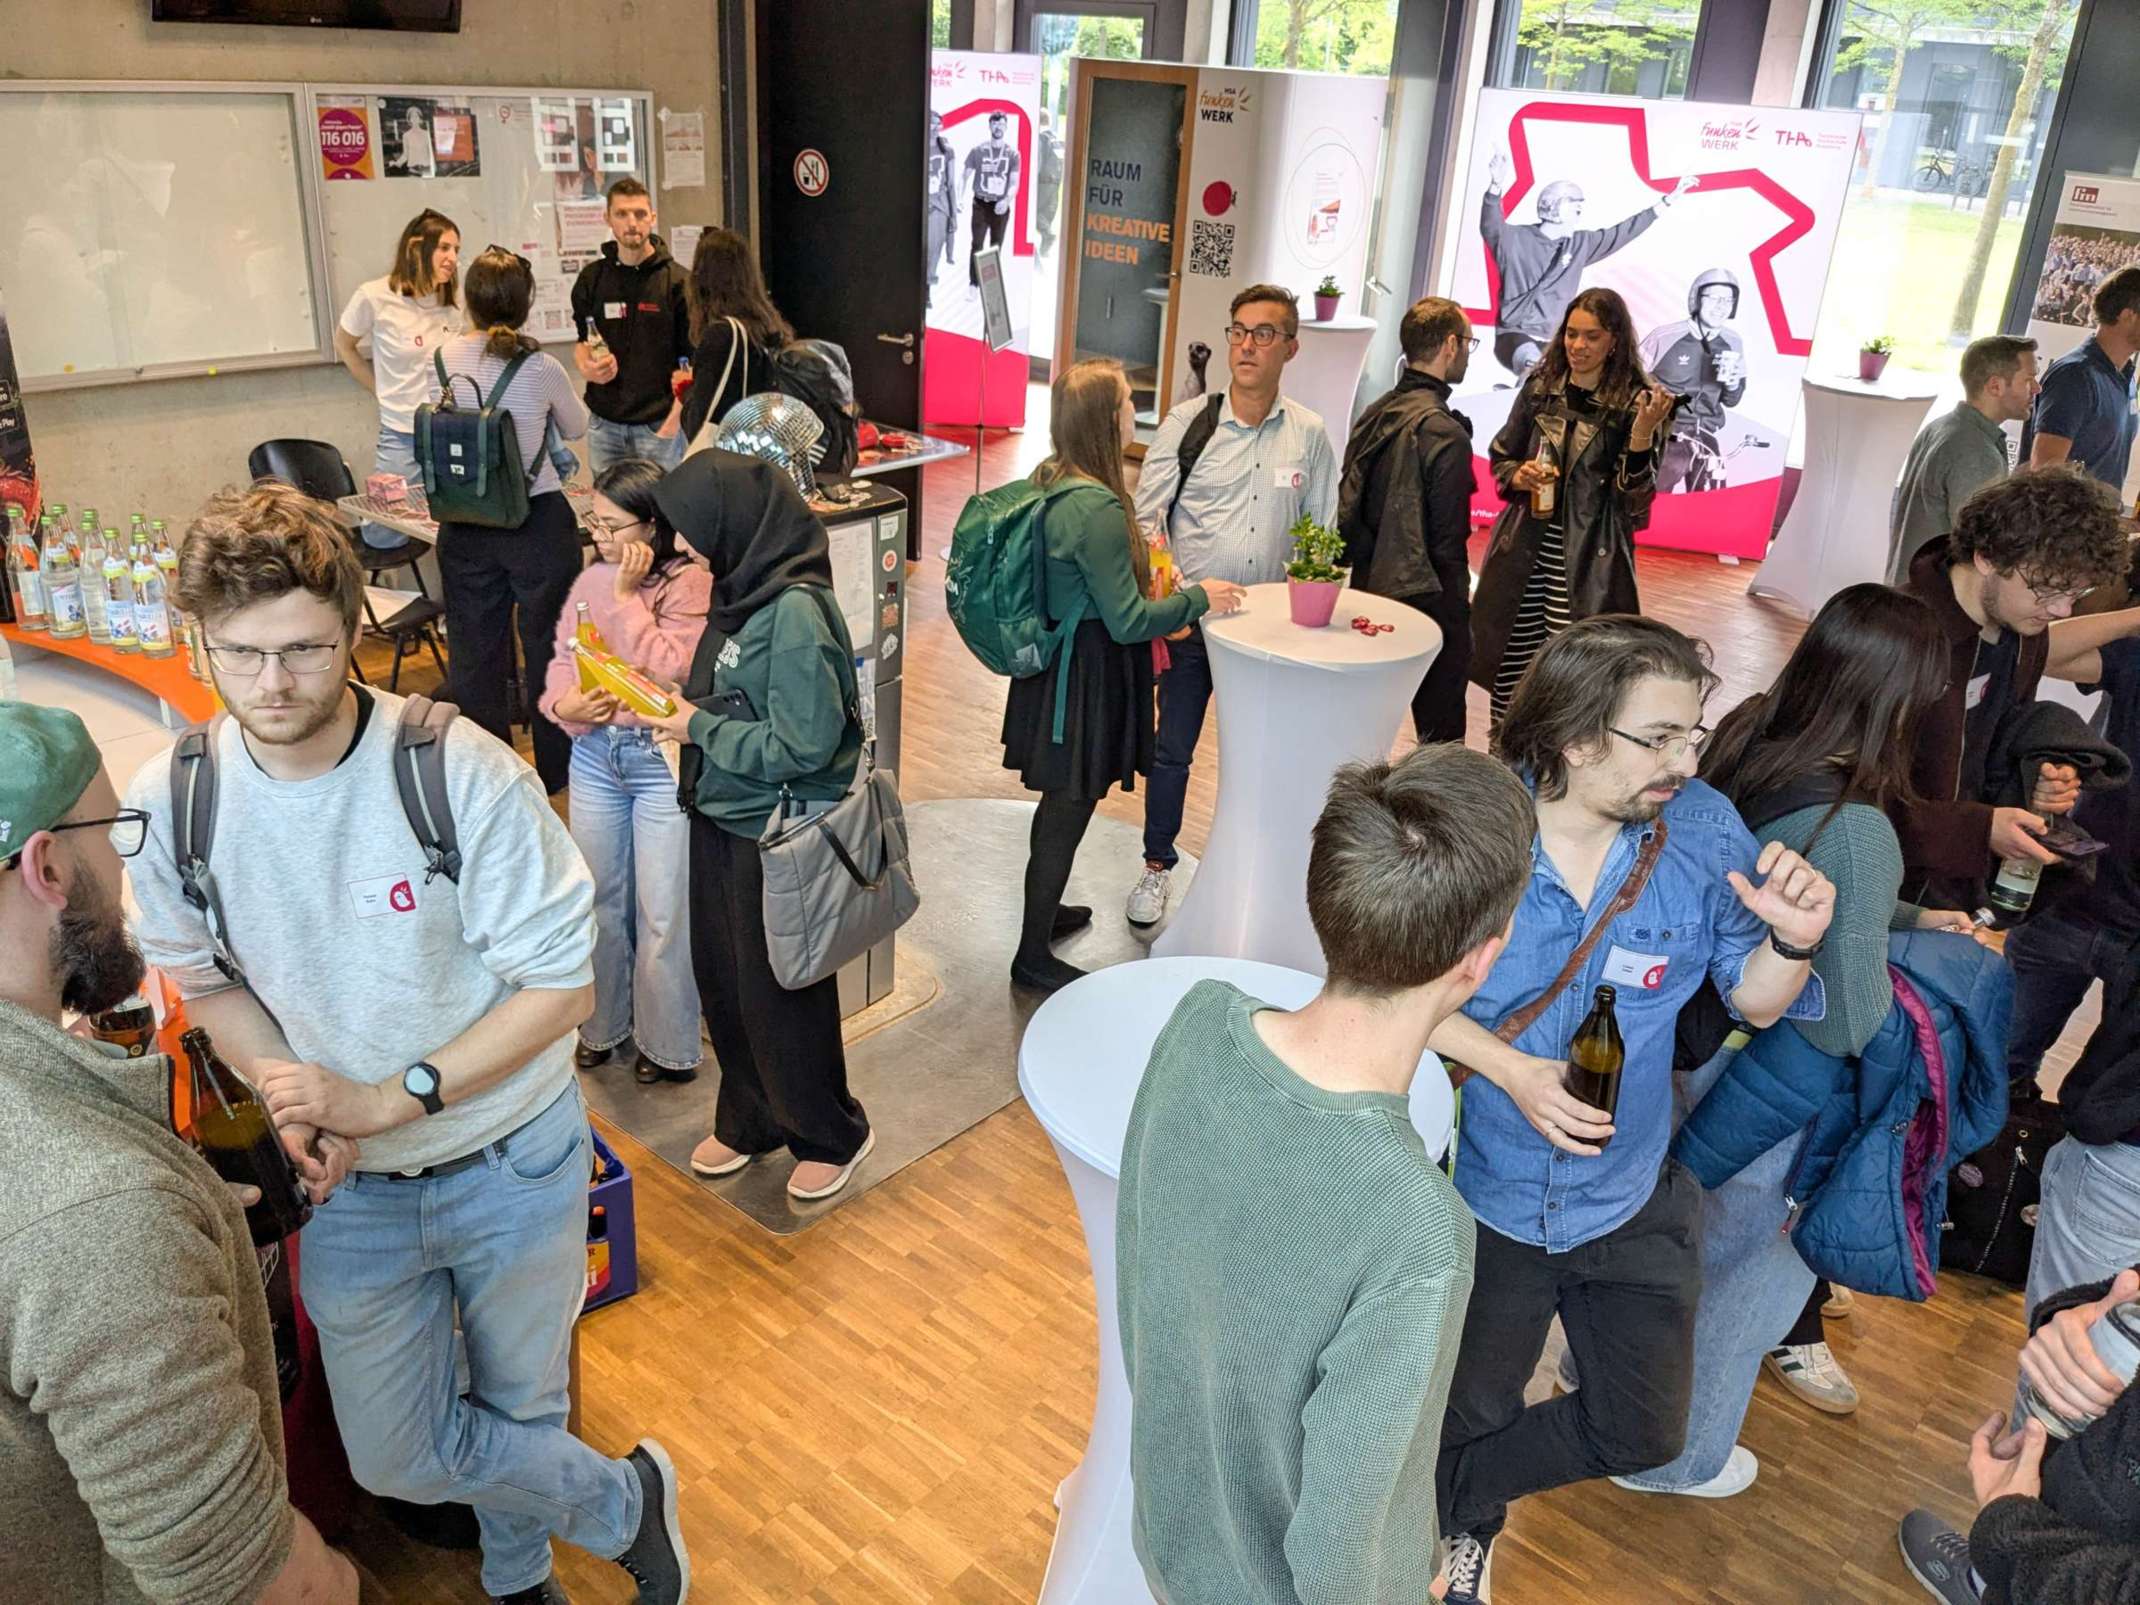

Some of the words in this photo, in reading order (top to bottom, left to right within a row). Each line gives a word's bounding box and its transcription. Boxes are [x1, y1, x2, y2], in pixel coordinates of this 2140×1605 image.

[1201, 109, 1234, 124] WERK
[321, 131, 341, 146] 116
[342, 131, 365, 146] 016
[1700, 138, 1739, 151] WERK
[1090, 160, 1142, 182] RAUM
[1088, 183, 1124, 207] FÜR
[1086, 212, 1170, 243] KREATIVE
[1084, 238, 1139, 266] IDEEN
